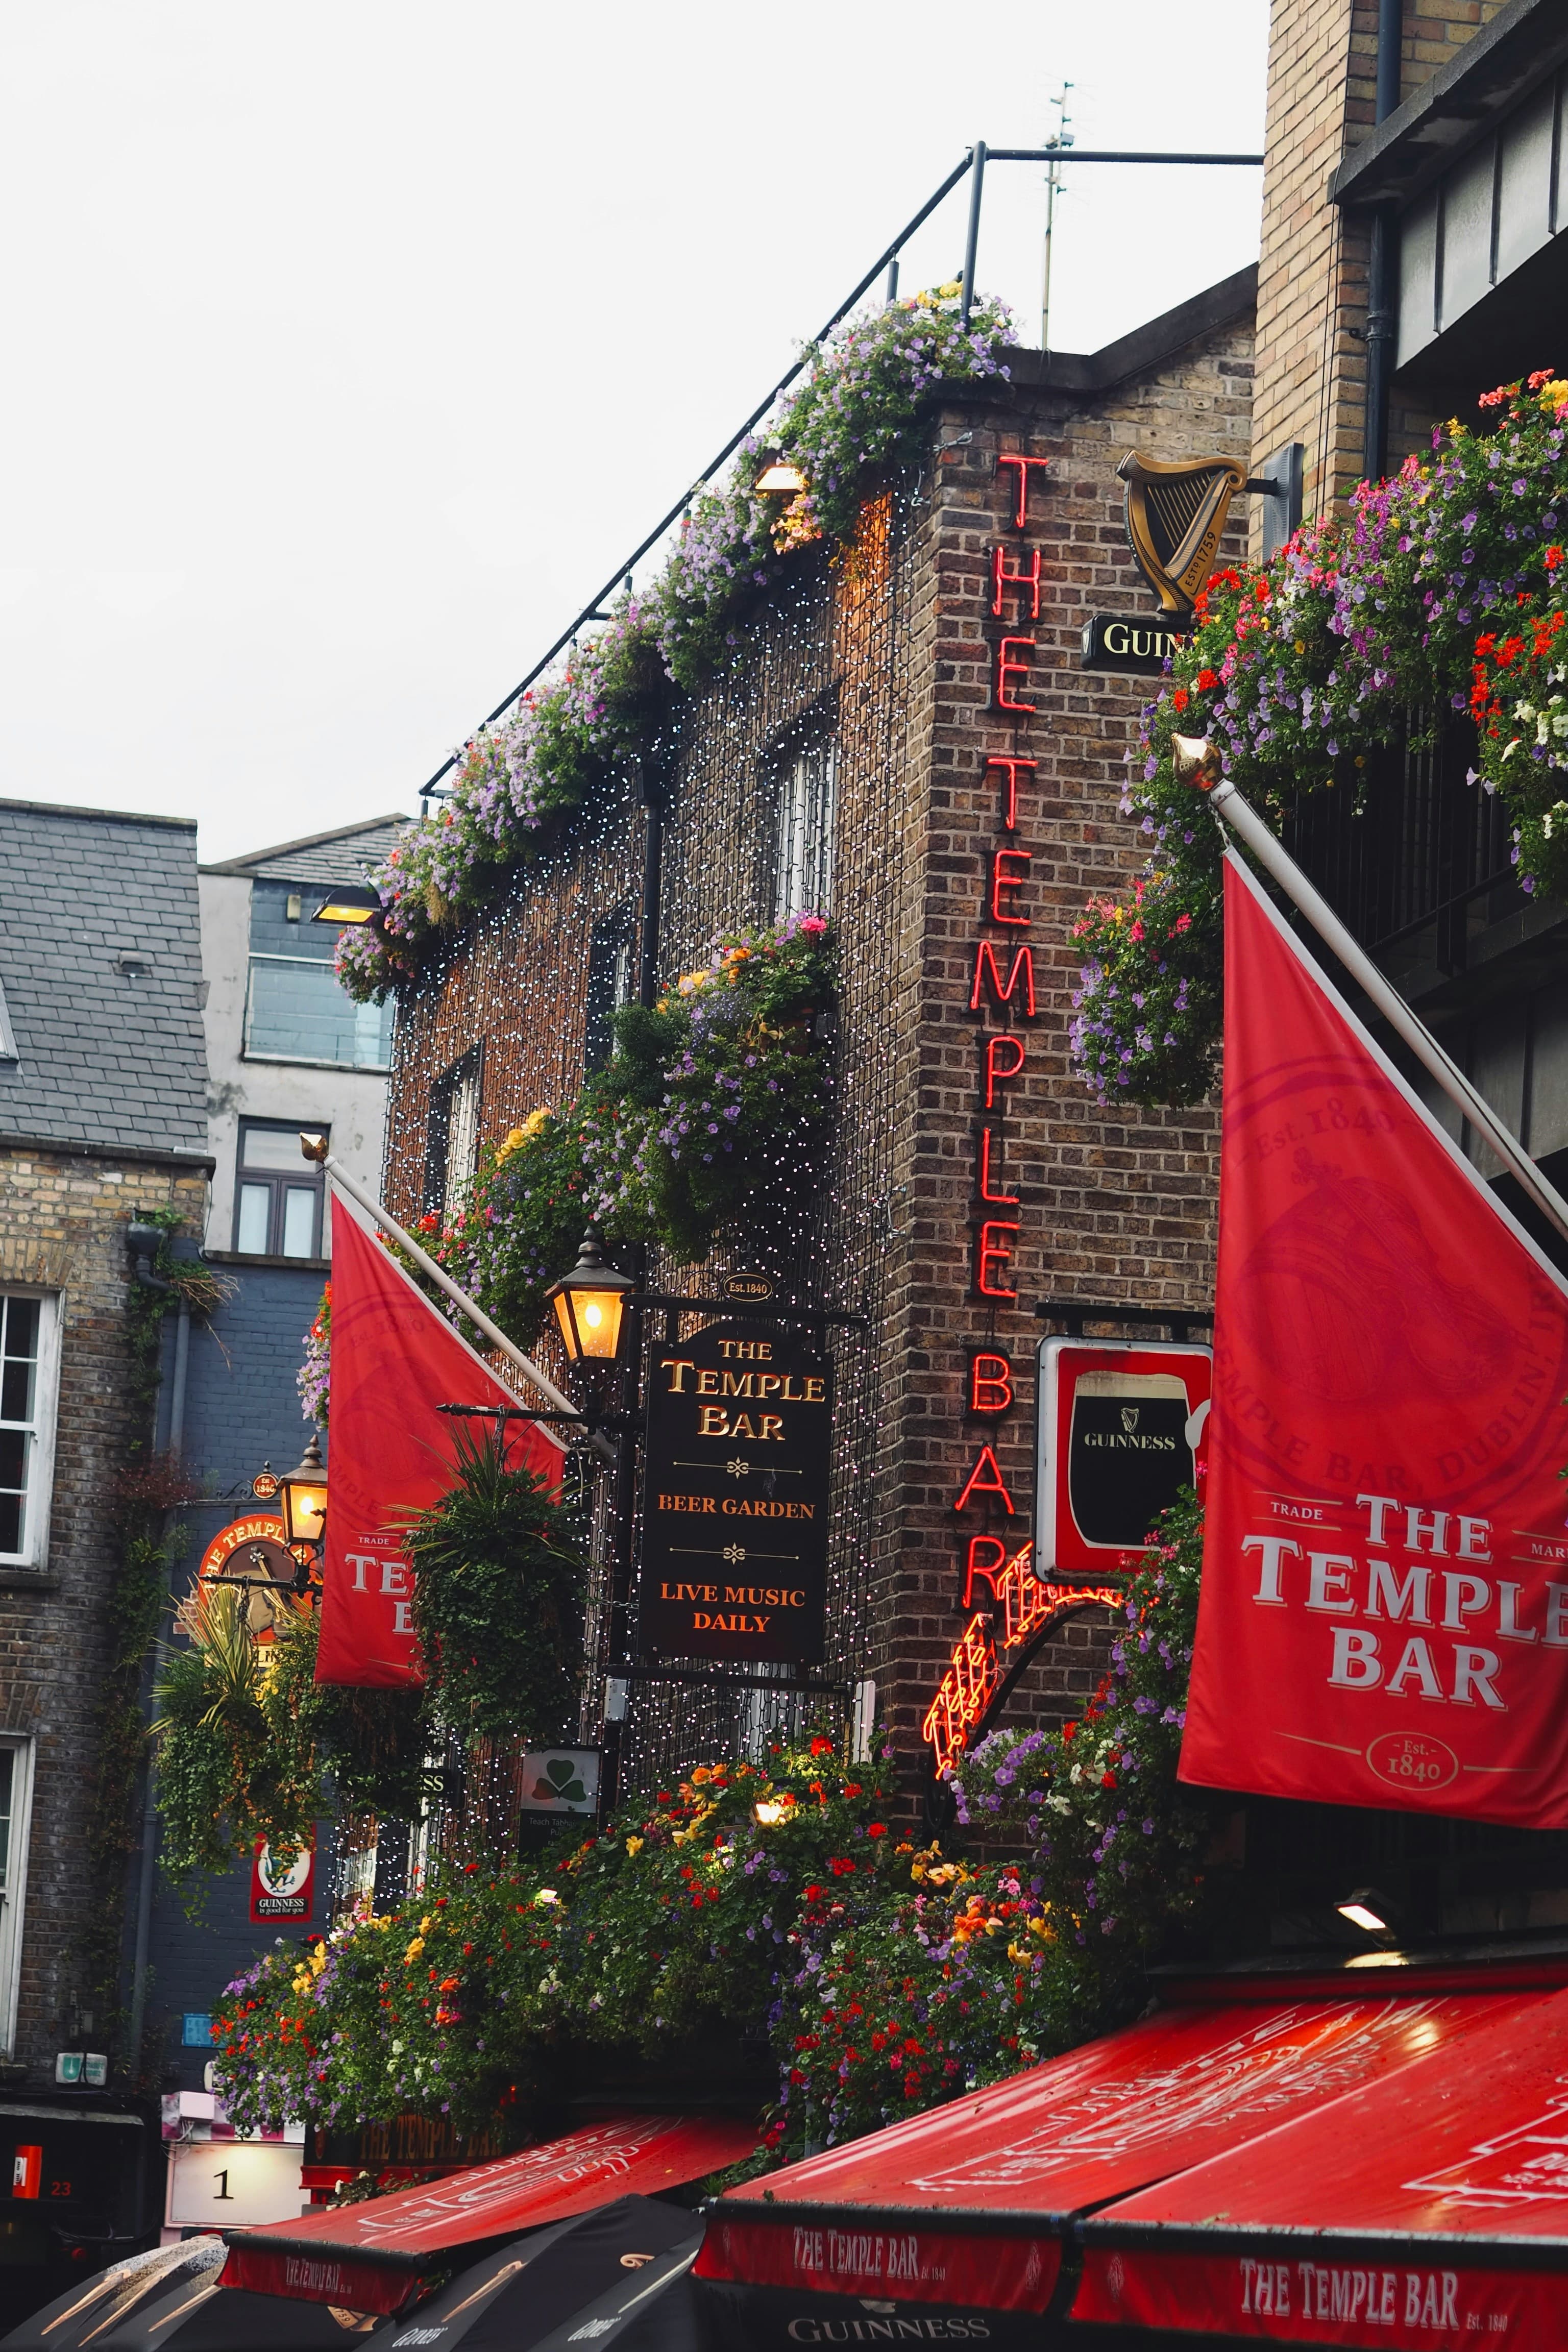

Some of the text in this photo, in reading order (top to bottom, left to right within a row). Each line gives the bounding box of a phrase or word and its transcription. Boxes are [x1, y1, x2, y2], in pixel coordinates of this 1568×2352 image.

[1196, 531, 1216, 562] 1759
[1104, 623, 1189, 658] GUIN
[952, 455, 1049, 1609] THE TEMPLE BAR
[718, 1339, 772, 1360] THE
[660, 1359, 826, 1402] TEMPLE
[697, 1405, 786, 1441] BAR
[1084, 1433, 1175, 1450] GUINNESS
[657, 1494, 816, 1519] BEER GARDEN
[1271, 1502, 1324, 1521] TRADE
[358, 1536, 390, 1545] TRADE
[1356, 1493, 1493, 1564] THE
[660, 1583, 805, 1607] LIVE MUSIC
[1241, 1535, 1568, 1649] TEMPLE
[693, 1612, 771, 1632] DAILY
[1327, 1627, 1508, 1711] BAR
[1388, 1754, 1441, 1782] 1840
[529, 1817, 550, 1826] Teach
[259, 1899, 304, 1907] GUINNESS
[52, 2181, 71, 2196] 23
[213, 2169, 234, 2199] 1
[793, 2226, 823, 2271] THE
[827, 2229, 884, 2276] TEMPLE
[887, 2235, 919, 2280] BAR
[932, 2267, 945, 2281] 1840
[1240, 2258, 1508, 2332] THE TEMPLE BAR Est. 1840
[334, 2308, 351, 2322] 759
[788, 2318, 990, 2342] GUINNESS
